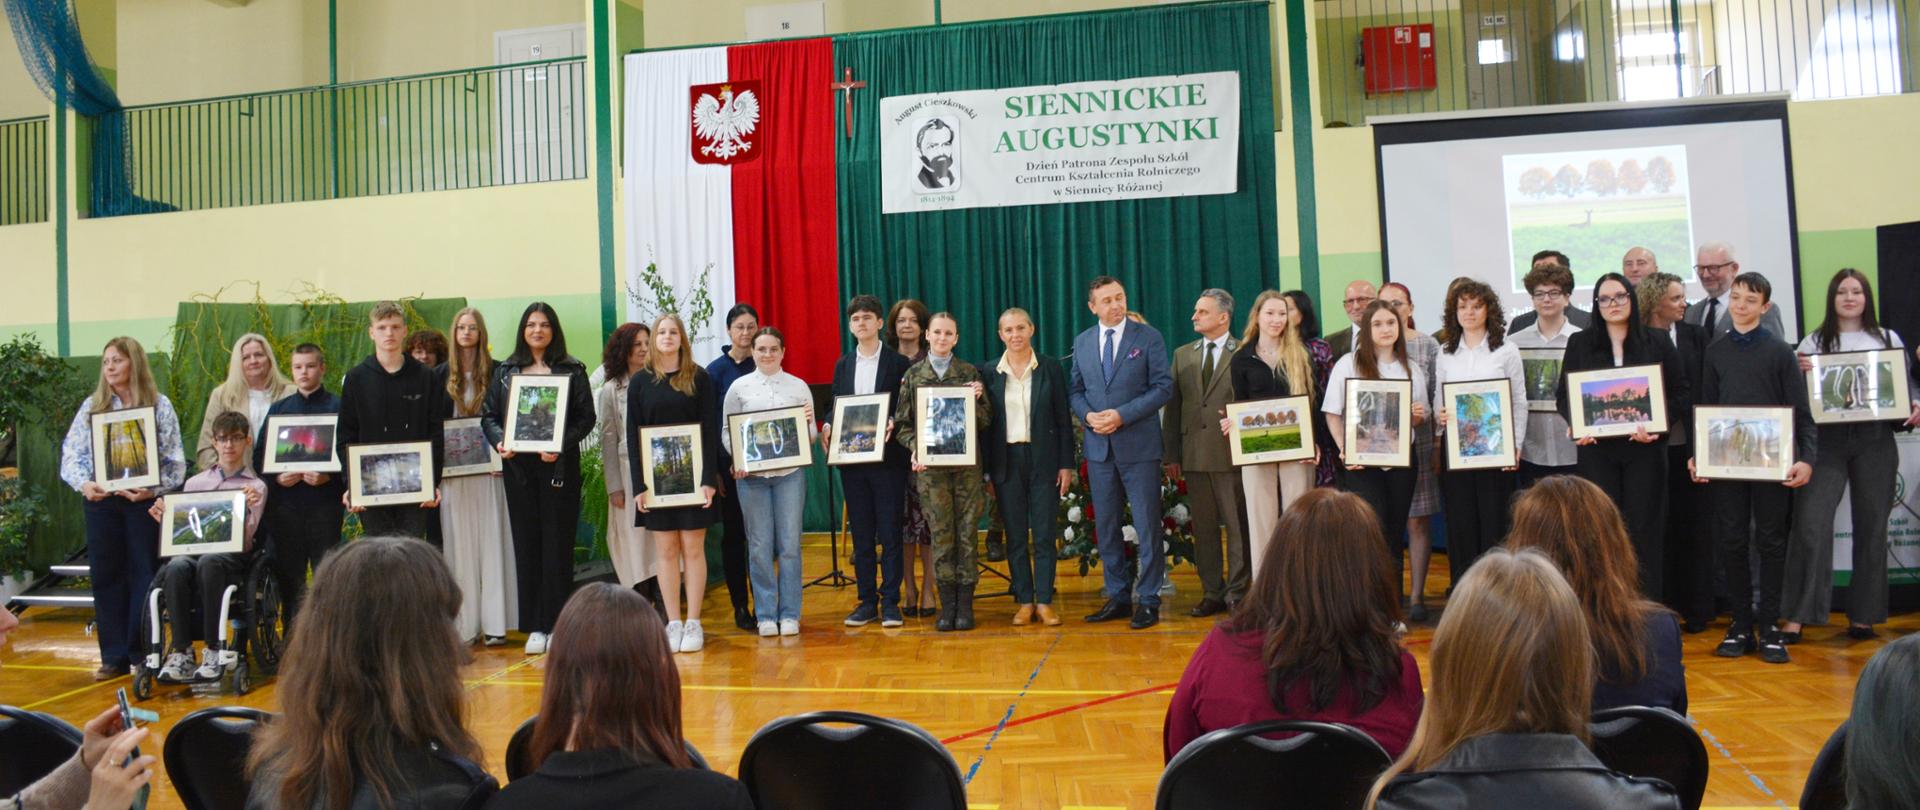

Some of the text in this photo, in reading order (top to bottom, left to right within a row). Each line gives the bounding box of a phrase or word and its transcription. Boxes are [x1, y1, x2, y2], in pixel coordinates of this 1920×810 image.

[781, 22, 790, 30] 18
[532, 46, 540, 54] 19
[1004, 84, 1207, 119] SIENNICKIE
[895, 98, 977, 126] August Cieszkowski
[993, 117, 1219, 153] AUGUSTYNKI
[1026, 161, 1058, 171] Dzień
[1061, 158, 1106, 169] Patrona
[1015, 174, 1065, 184] Centrum
[1137, 165, 1201, 177] Rolniczego
[1053, 180, 1163, 197] w Siennicy Różanej
